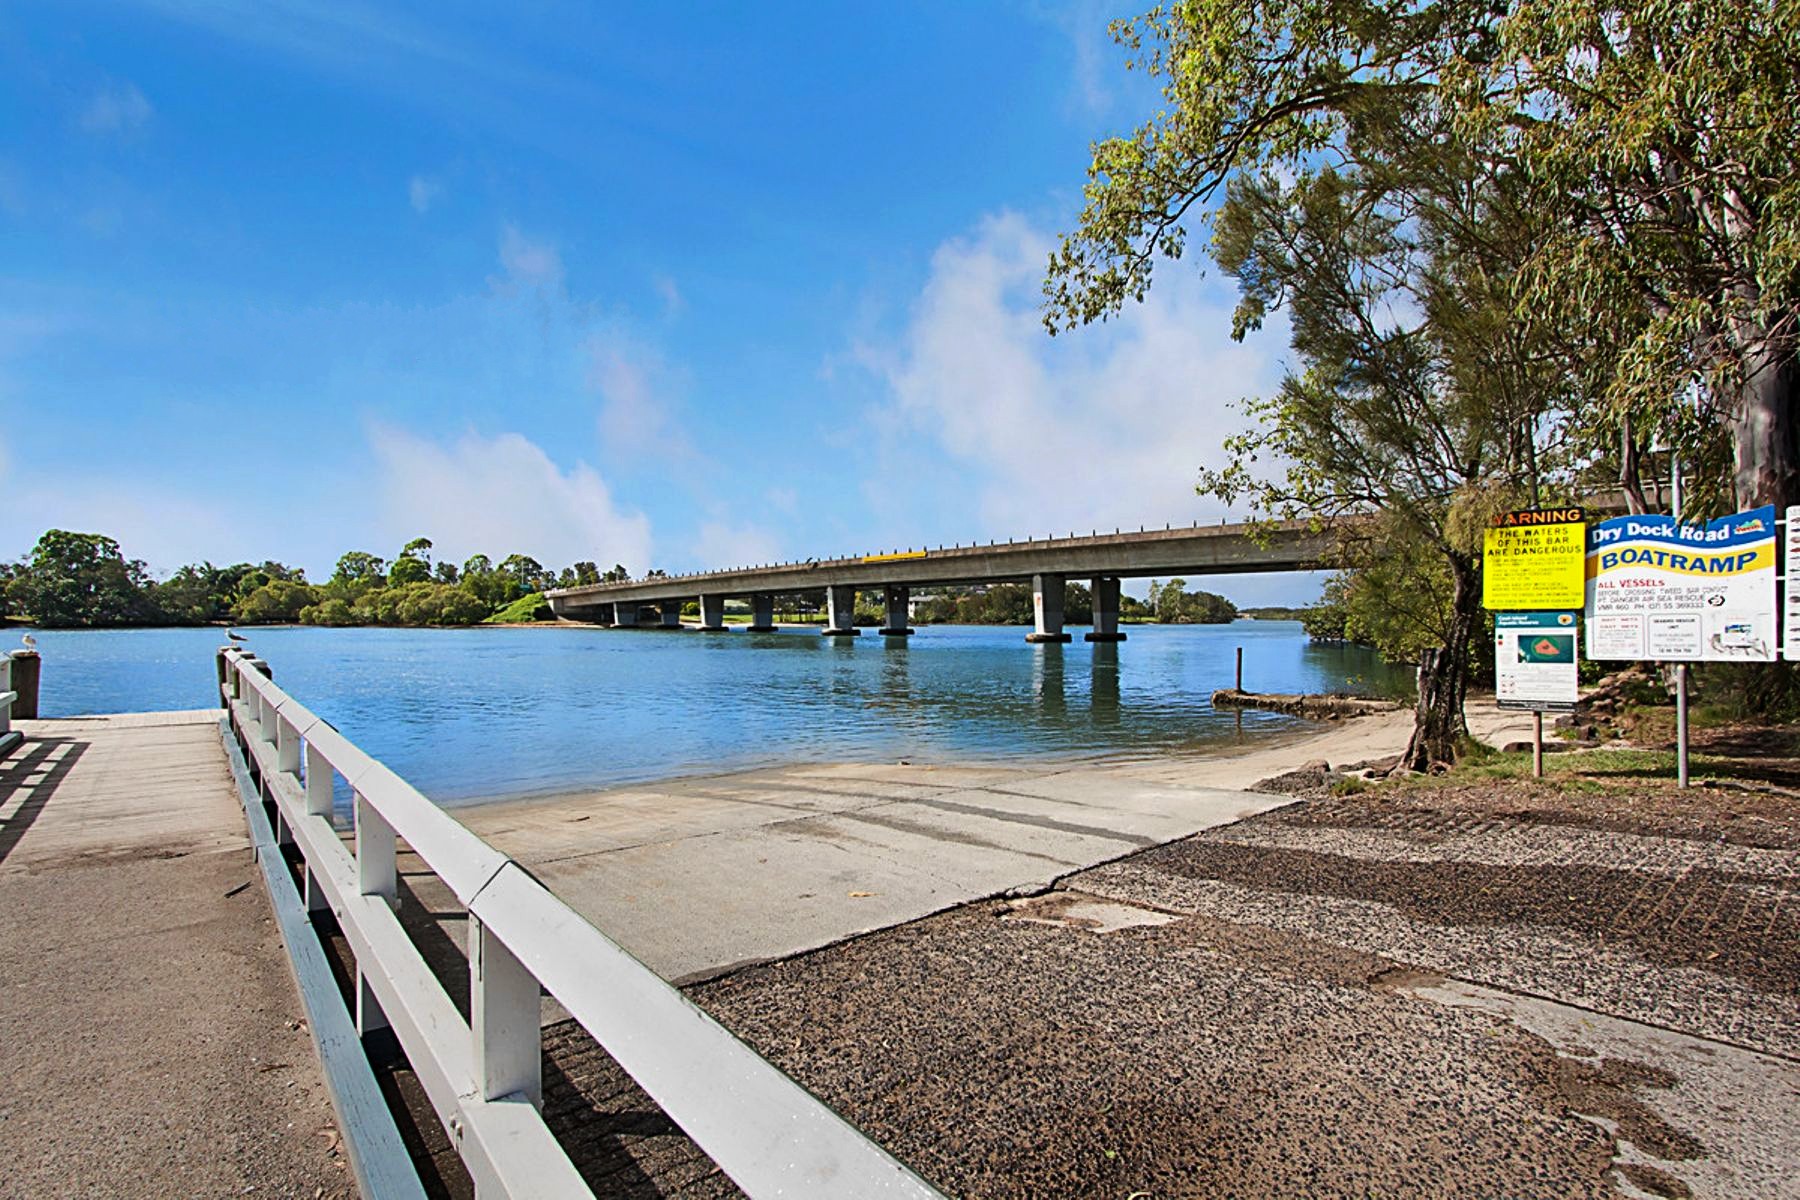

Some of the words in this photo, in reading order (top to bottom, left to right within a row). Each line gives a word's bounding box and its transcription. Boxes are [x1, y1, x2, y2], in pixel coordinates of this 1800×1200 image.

[1499, 530, 1519, 538] THE
[1524, 528, 1568, 536] WATERS
[1592, 527, 1622, 543] Dry
[1627, 522, 1674, 538] Dock
[1679, 523, 1730, 542] Road
[1497, 539, 1510, 547] OF
[1517, 538, 1541, 546] THIS
[1546, 537, 1569, 545] BAR
[1488, 548, 1508, 556] ARE
[1514, 545, 1581, 555] DANGEROUS
[1601, 548, 1758, 573] BOATRAMP
[1598, 581, 1616, 589] ALL
[1619, 579, 1665, 588] VESSELS
[1674, 594, 1705, 602] RESCUE
